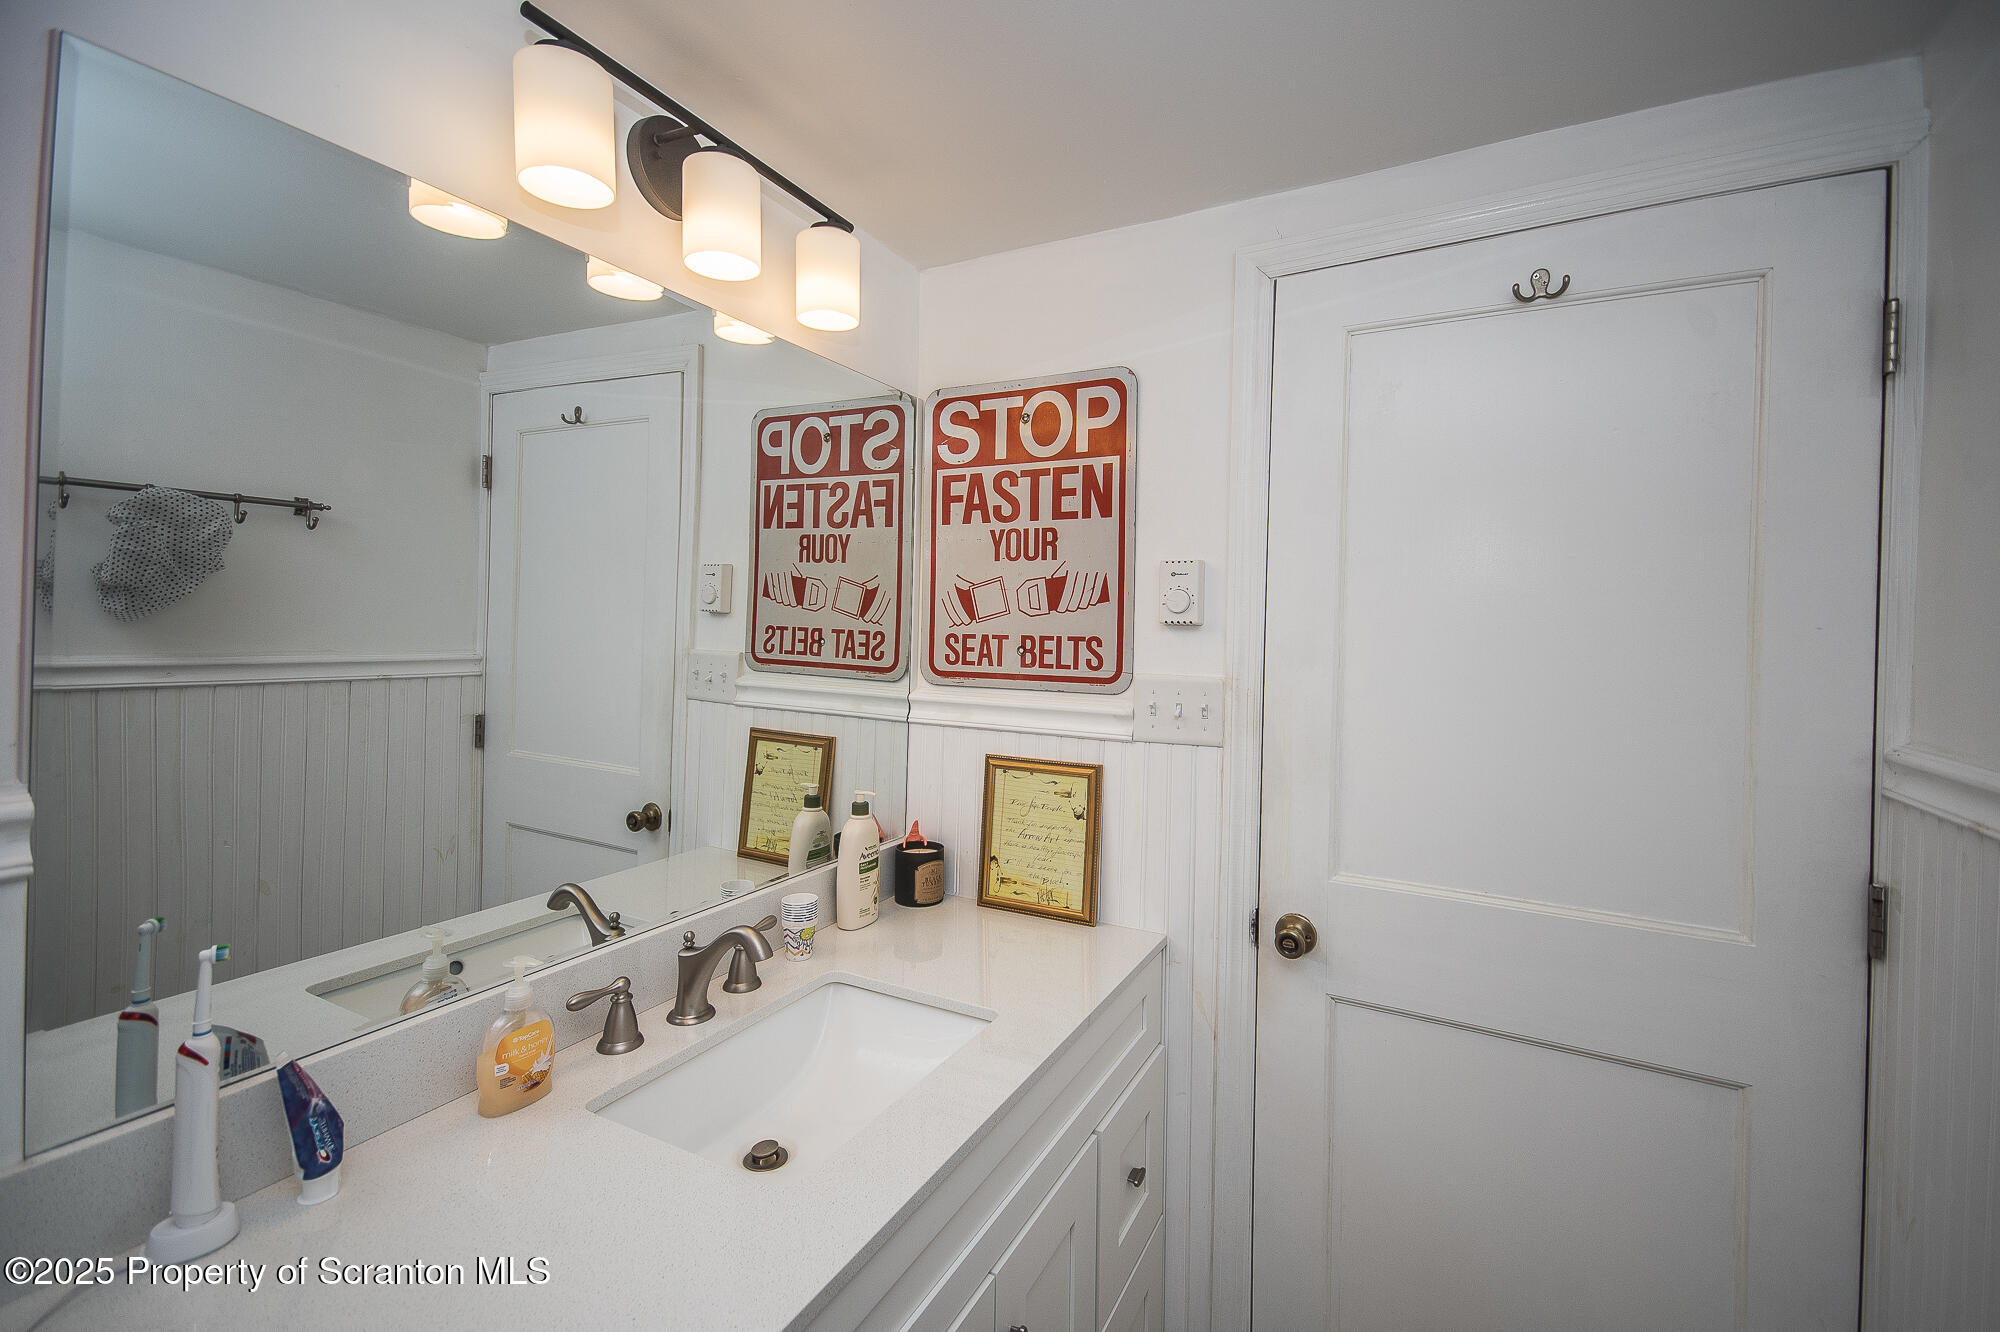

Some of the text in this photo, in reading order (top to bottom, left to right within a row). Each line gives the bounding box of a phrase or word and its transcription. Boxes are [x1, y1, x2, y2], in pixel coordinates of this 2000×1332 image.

[937, 385, 1121, 465] STOP
[941, 462, 1114, 526] FASTEN
[989, 527, 1059, 562] YOUR
[944, 632, 1104, 671] SEAT BELTS
[502, 1049, 520, 1060] milk
